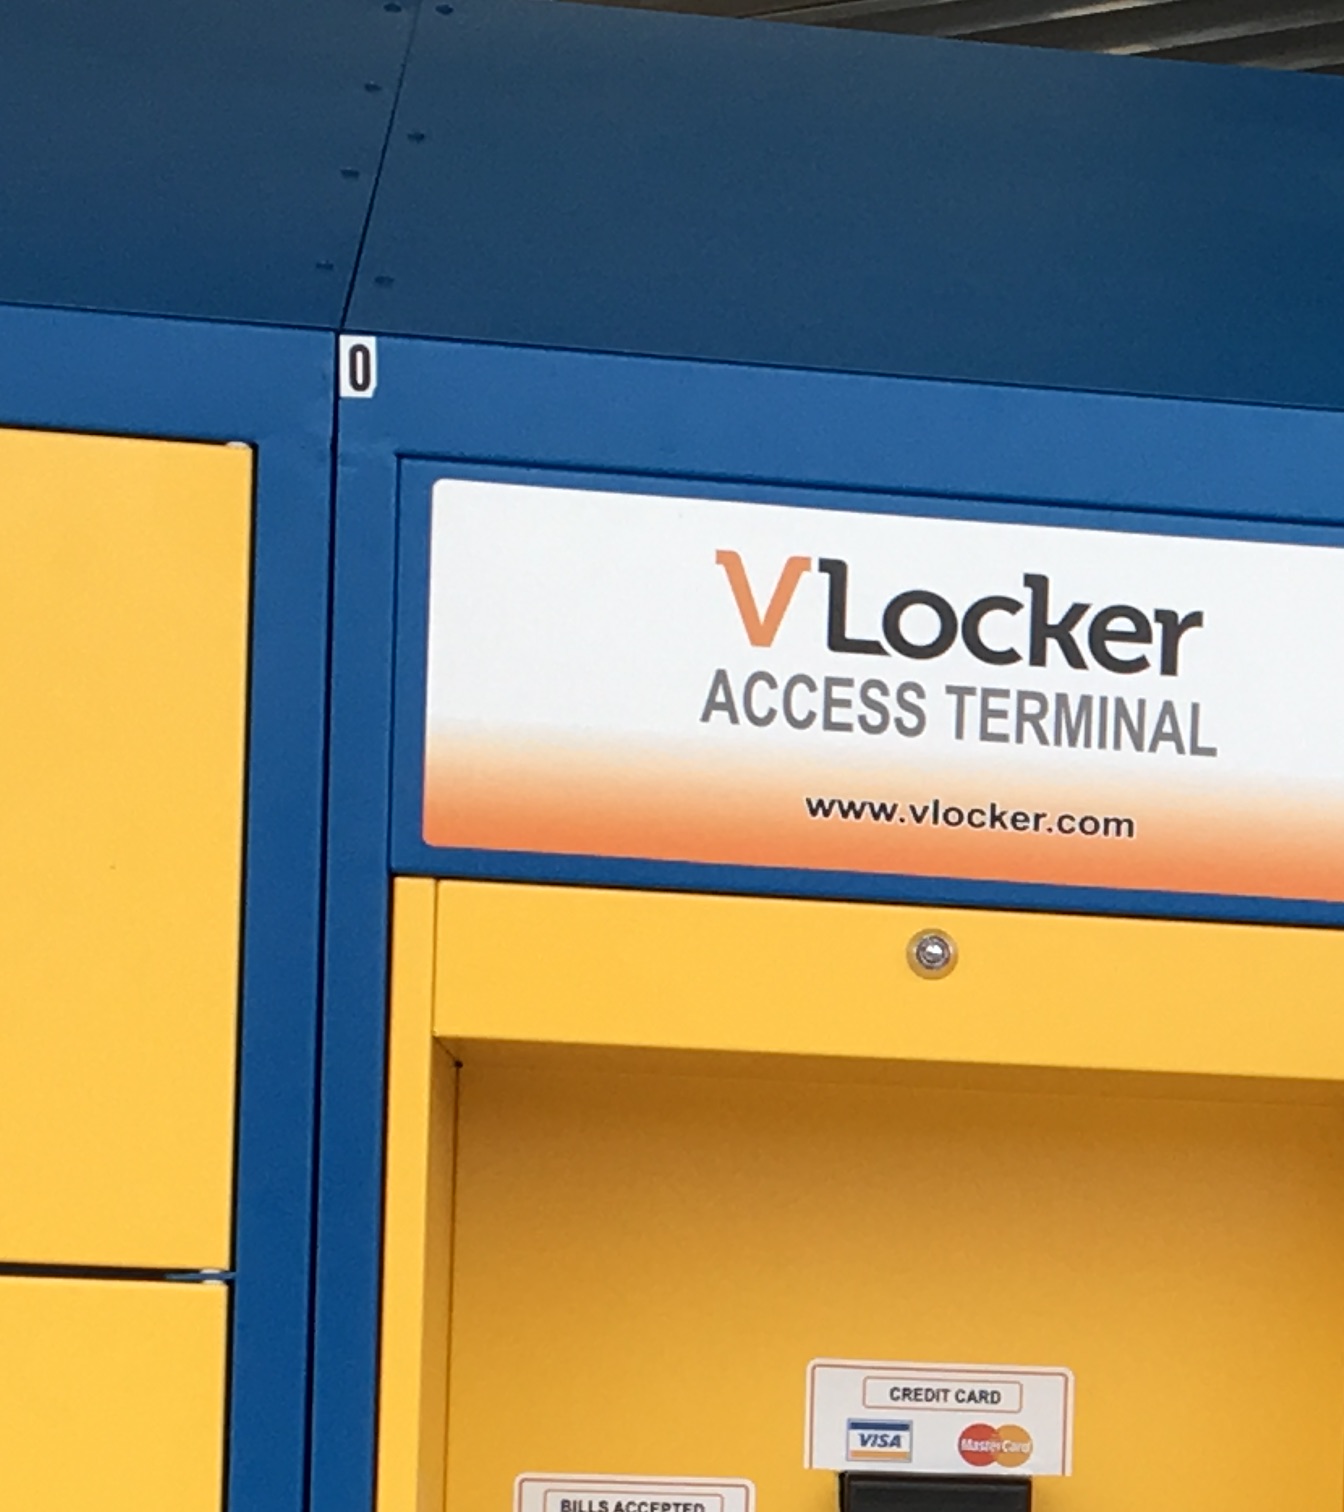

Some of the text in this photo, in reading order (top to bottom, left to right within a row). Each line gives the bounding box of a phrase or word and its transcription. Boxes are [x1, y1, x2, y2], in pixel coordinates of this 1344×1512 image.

[715, 549, 1204, 677] VLocker
[700, 668, 1218, 757] ACCESS TERMINAL
[805, 797, 1135, 839] www.vlocker.com
[889, 1387, 1001, 1404] CREDIT CARD
[858, 1433, 1032, 1454] VISA MasterCard
